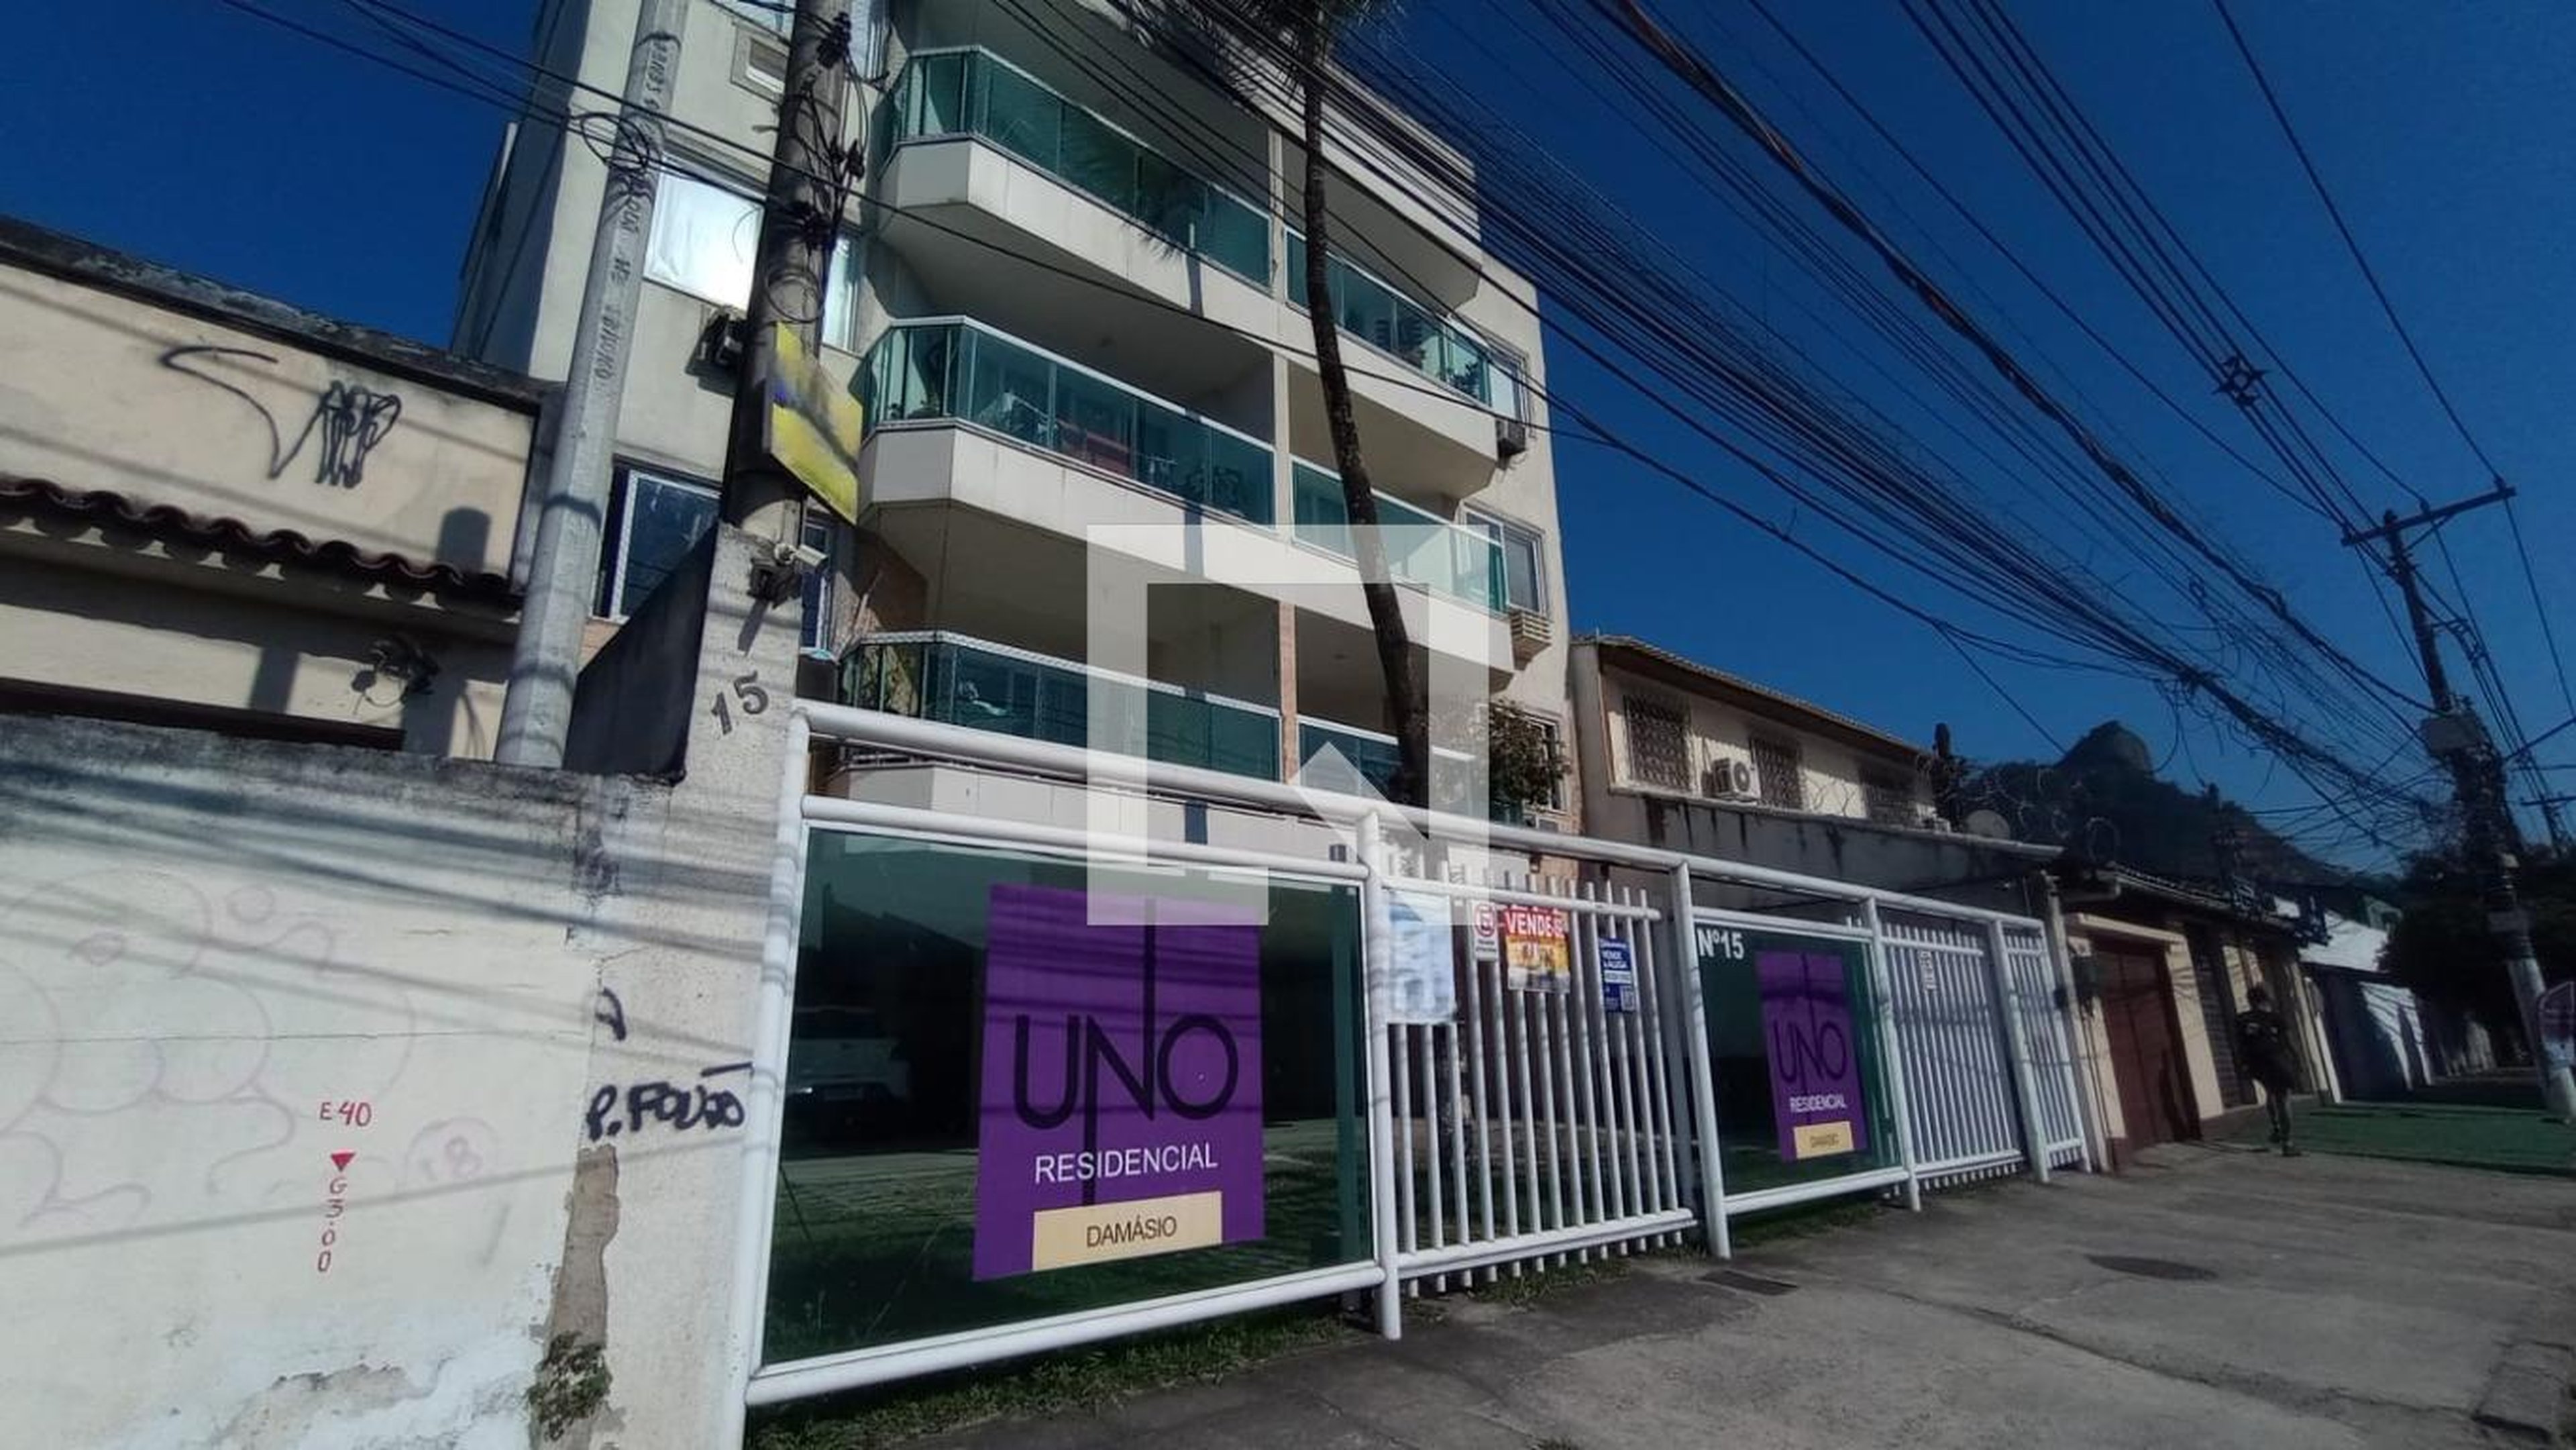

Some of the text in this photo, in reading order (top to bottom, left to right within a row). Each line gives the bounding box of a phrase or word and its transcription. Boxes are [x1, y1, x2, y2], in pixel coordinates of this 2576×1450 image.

[711, 670, 769, 735] 15
[1035, 1143, 1218, 1184] RESIDENCIAL
[1086, 1215, 1178, 1248] DAMÁSIO
